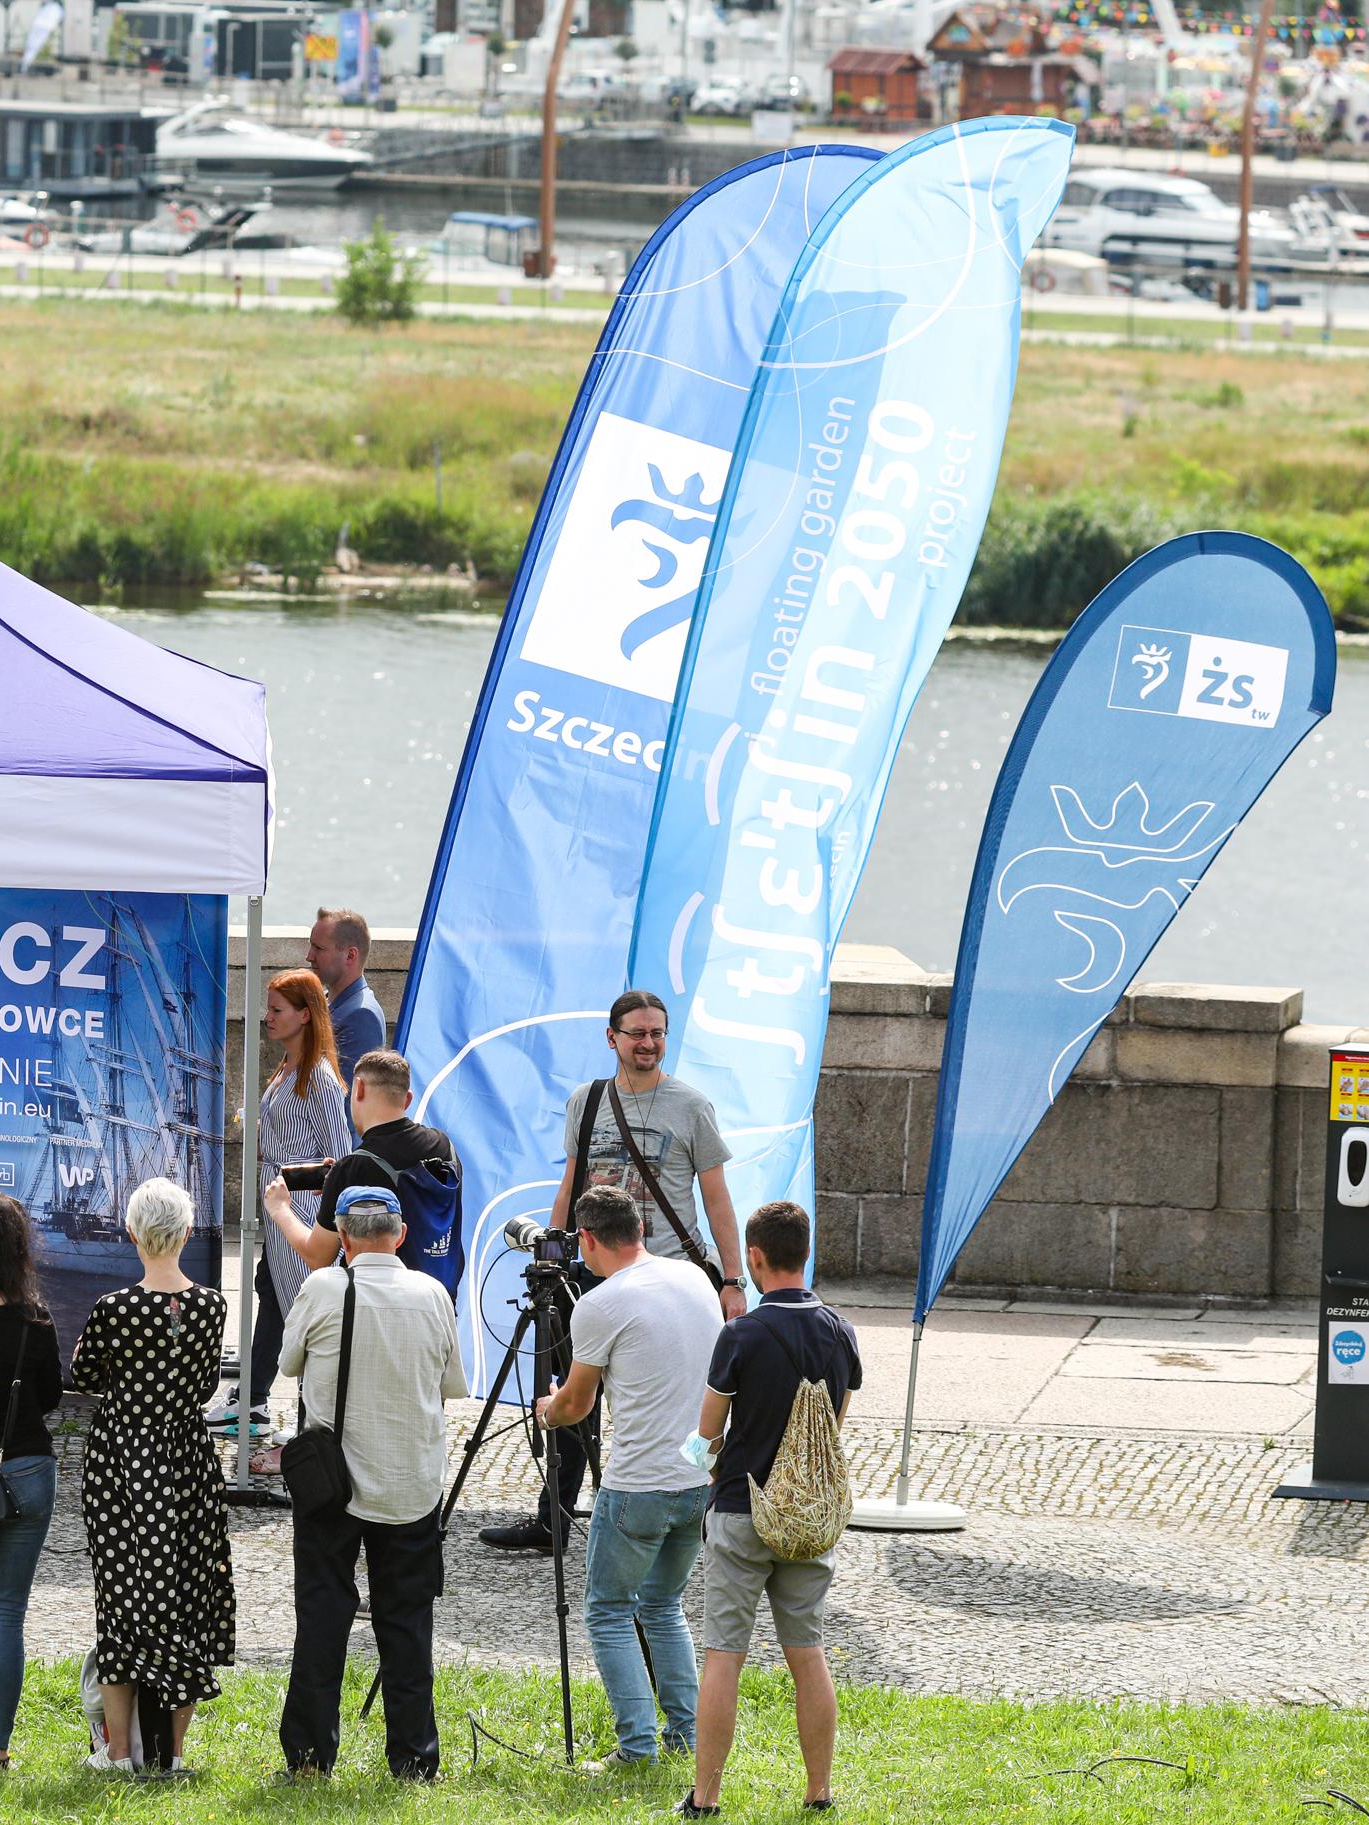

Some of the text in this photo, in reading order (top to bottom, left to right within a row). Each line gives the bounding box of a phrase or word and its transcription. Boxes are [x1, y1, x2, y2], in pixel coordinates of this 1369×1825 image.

[751, 396, 855, 696] floating garden
[826, 400, 935, 620] 2050
[917, 426, 977, 568] project
[50, 1137, 76, 1147] PARTNER
[1336, 1348, 1361, 1359] ręce
